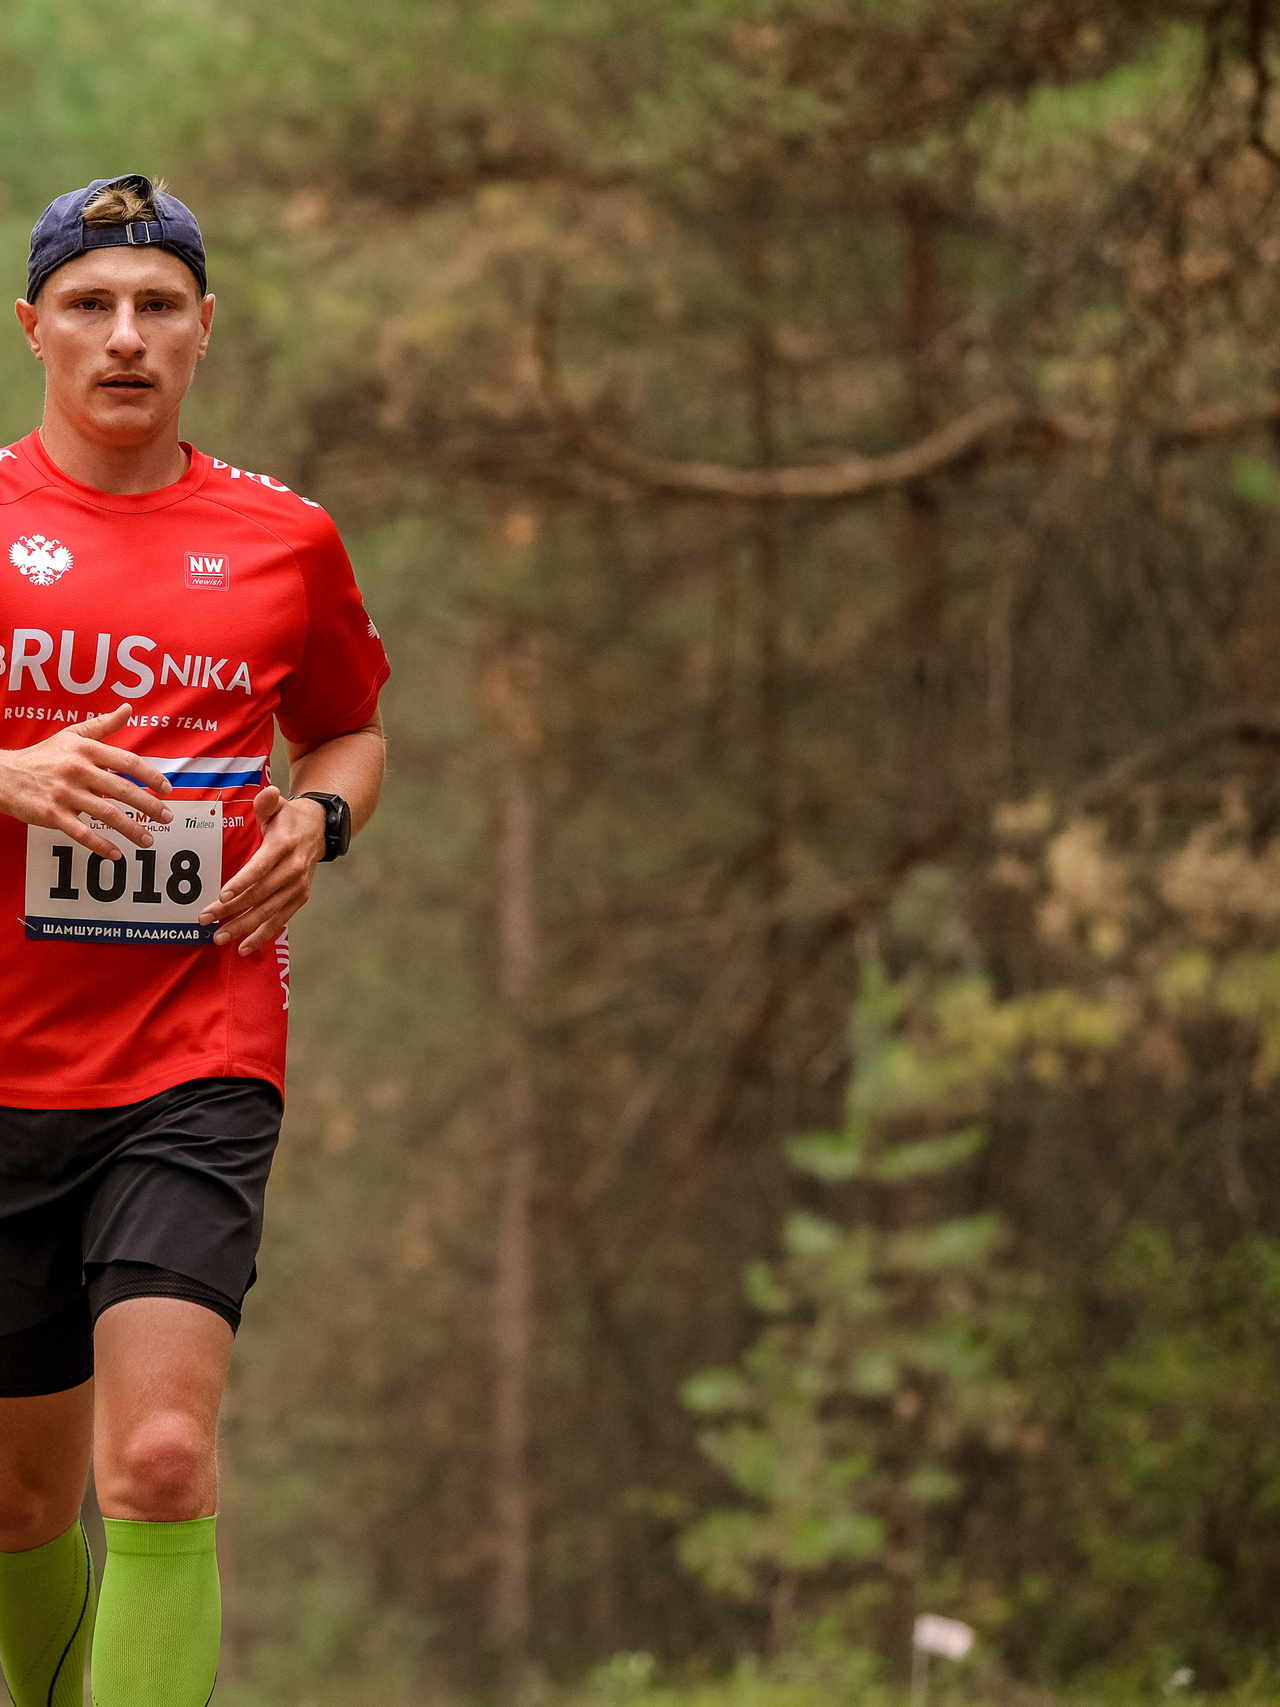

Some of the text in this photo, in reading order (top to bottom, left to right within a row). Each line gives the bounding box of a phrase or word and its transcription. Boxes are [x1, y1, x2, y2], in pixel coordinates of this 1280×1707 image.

[189, 555, 224, 573] NW
[192, 578, 223, 586] Newish
[4, 706, 218, 732] RUSSIAN BNESS TEAM
[185, 817, 215, 829] Triatleta
[222, 816, 244, 828] eam
[49, 845, 203, 905] 1018
[42, 923, 200, 940] ШАМШУРИН ВЛАДИСЛАВ
